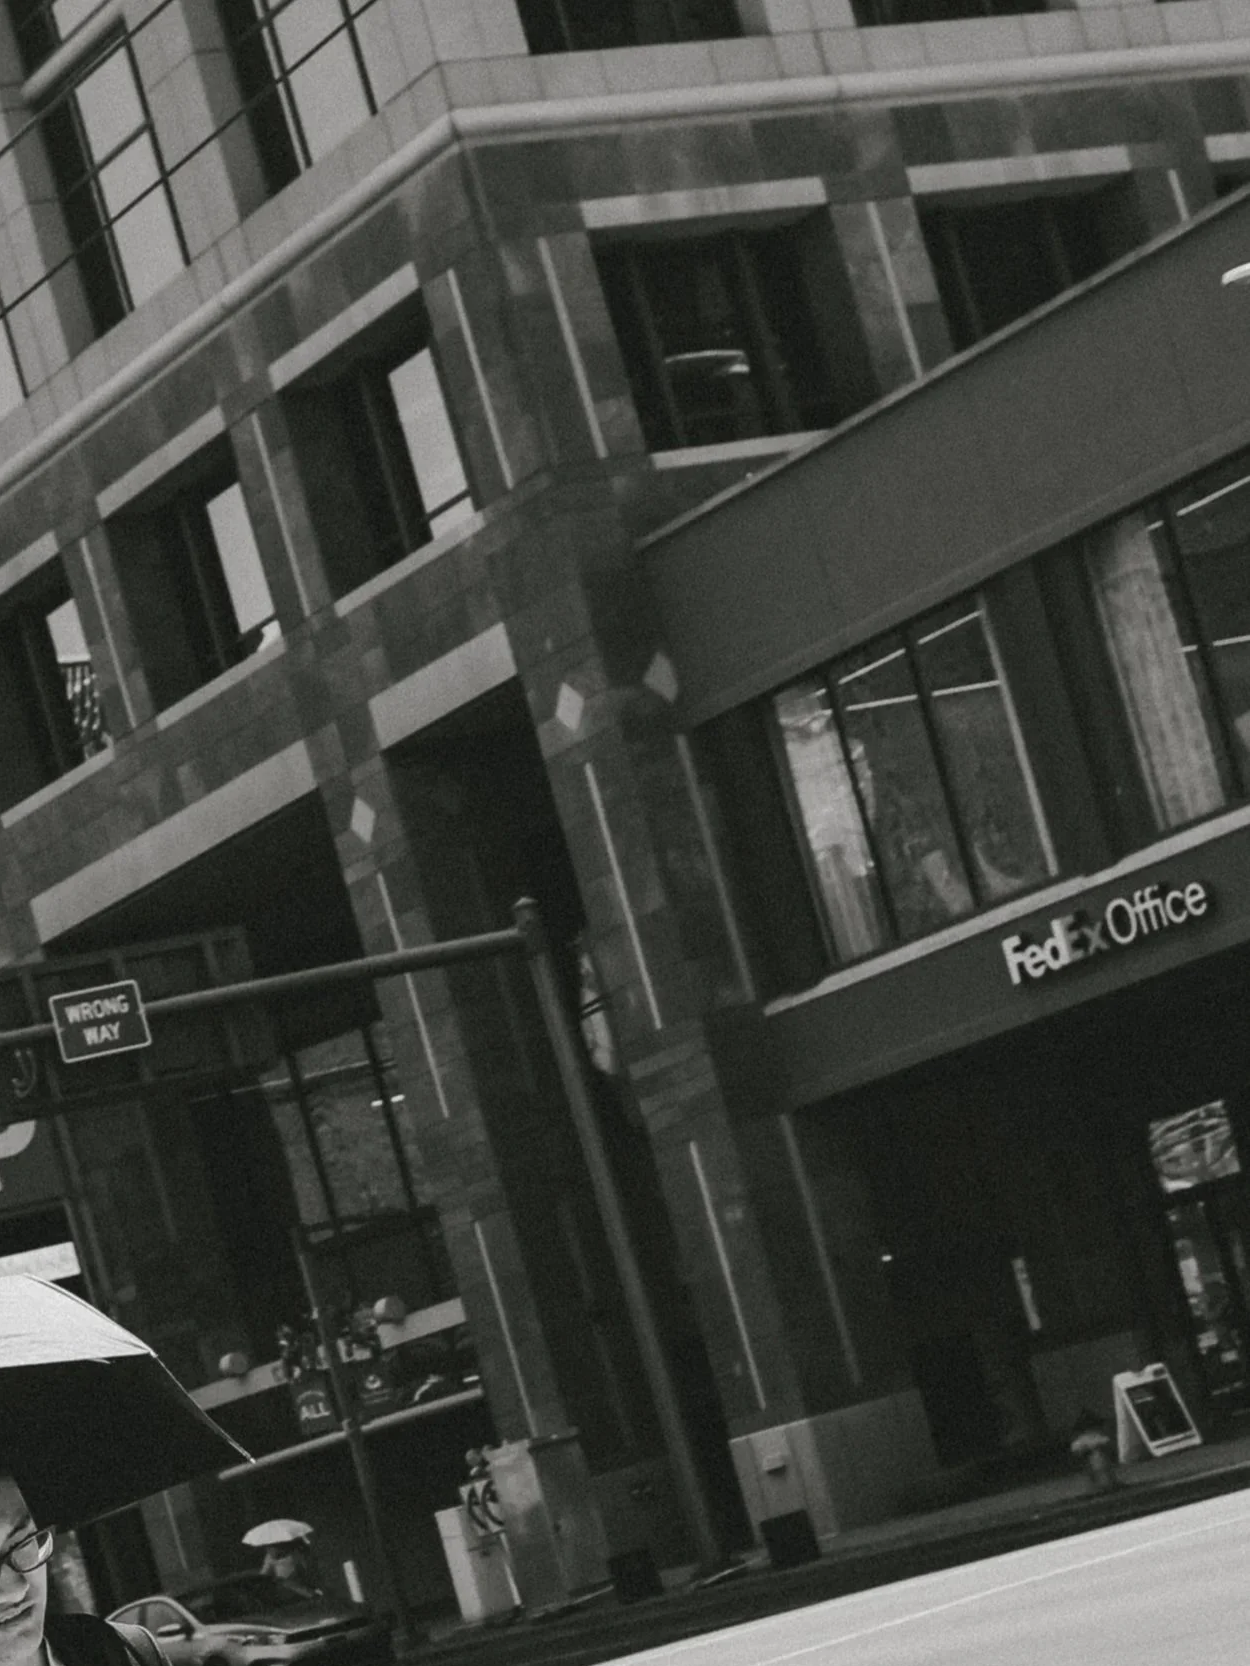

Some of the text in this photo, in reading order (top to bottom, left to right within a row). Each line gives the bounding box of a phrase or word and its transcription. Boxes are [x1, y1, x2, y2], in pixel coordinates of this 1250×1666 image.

[1001, 882, 1208, 985] FedEx Office
[64, 994, 130, 1025] WRONG
[82, 1021, 121, 1046] WAY
